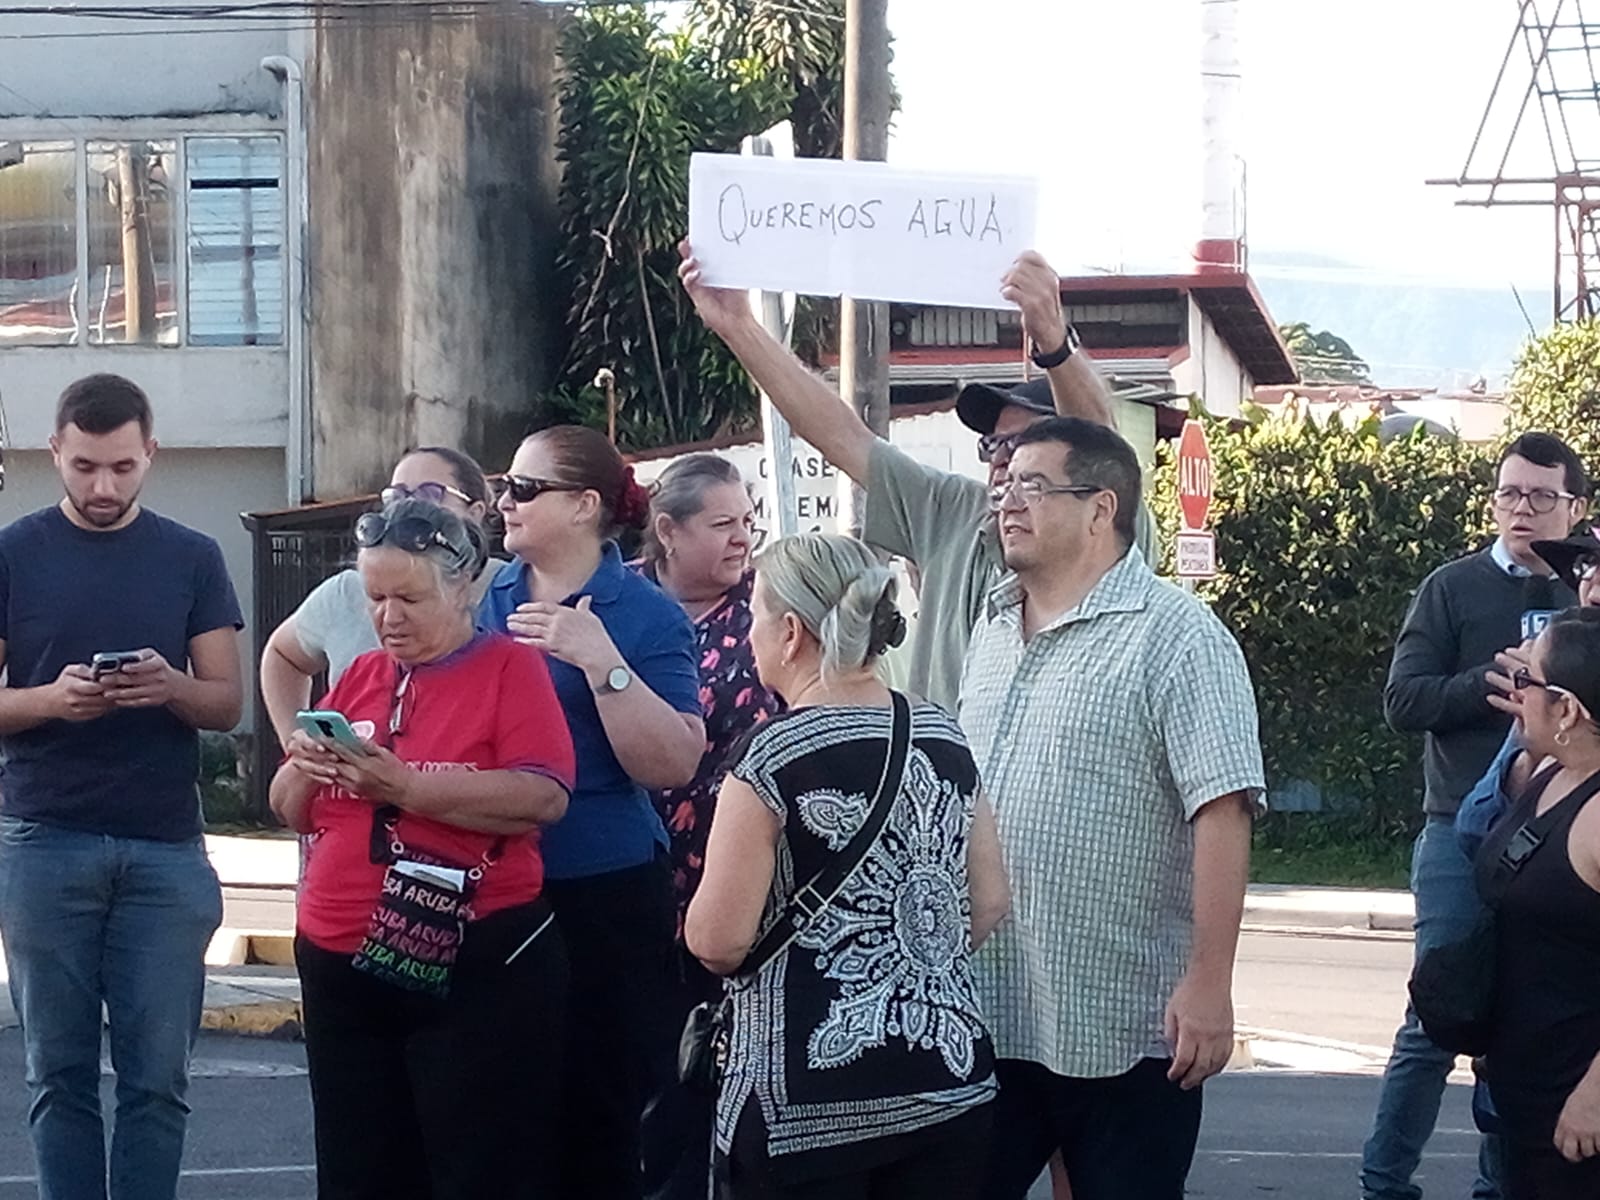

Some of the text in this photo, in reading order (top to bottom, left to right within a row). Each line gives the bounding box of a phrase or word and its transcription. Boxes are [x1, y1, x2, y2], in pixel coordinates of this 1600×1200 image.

[719, 183, 882, 245] QUEREMOS
[1181, 455, 1209, 498] ALTO
[403, 885, 457, 914] ARUBA
